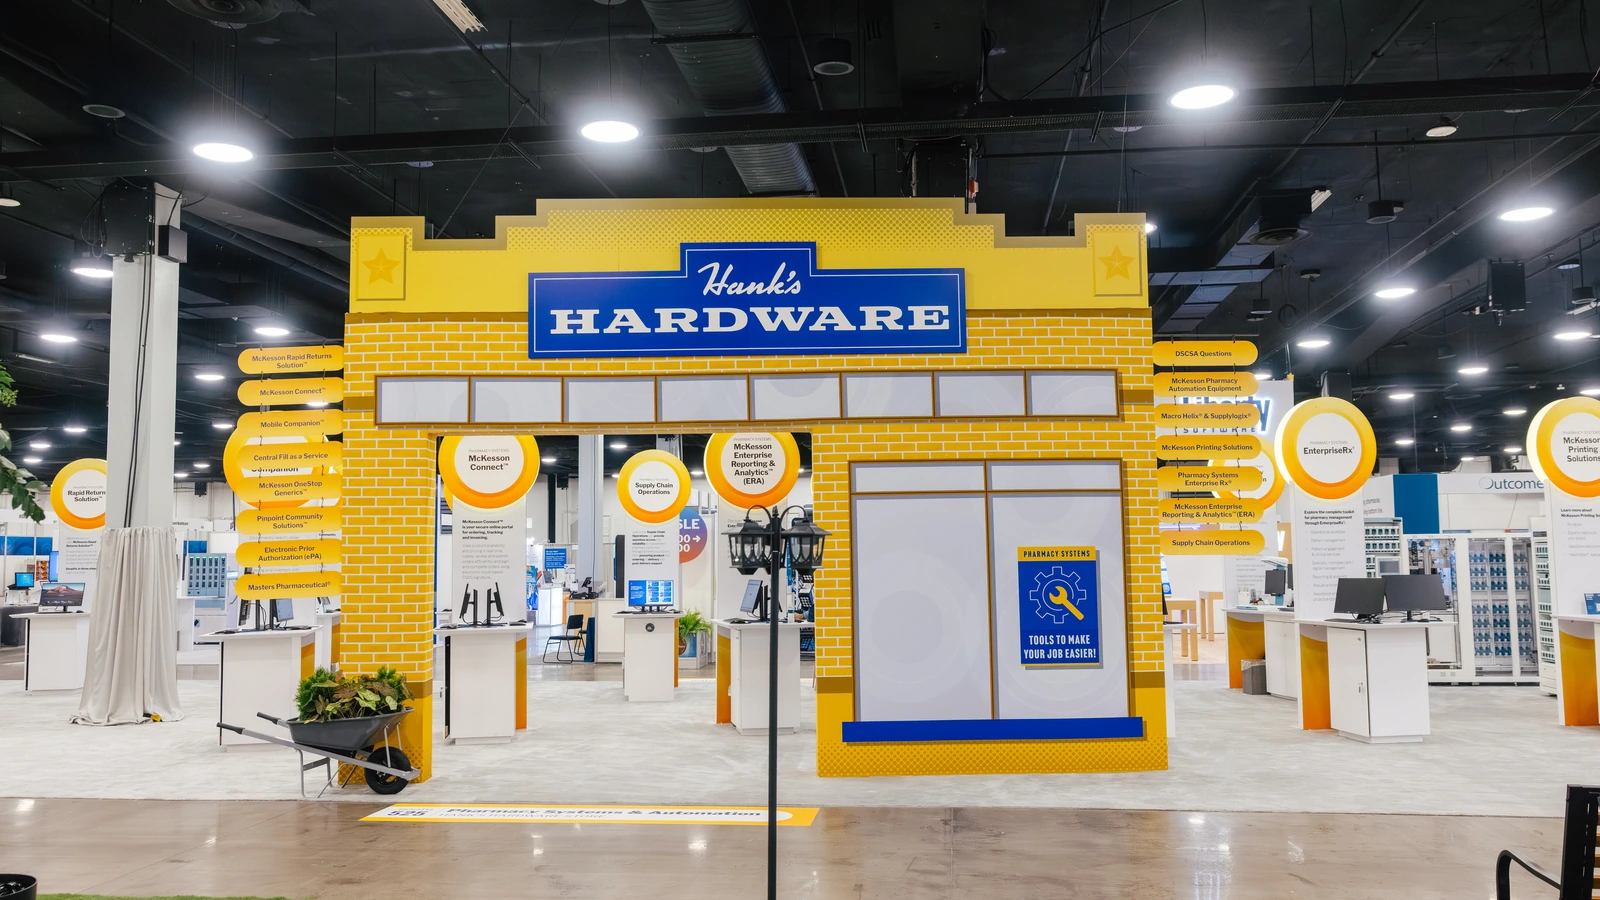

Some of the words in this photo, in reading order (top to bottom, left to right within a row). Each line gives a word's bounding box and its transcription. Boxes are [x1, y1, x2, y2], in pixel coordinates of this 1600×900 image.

[698, 262, 801, 296] Hank's
[550, 305, 950, 334] HARDWARE
[1029, 635, 1054, 645] TOOLS
[1056, 635, 1066, 644] TO
[1068, 635, 1090, 644] MAKE
[1024, 649, 1045, 659] YOUR
[1047, 649, 1063, 659] JOB
[1065, 648, 1096, 658] EASIER!
